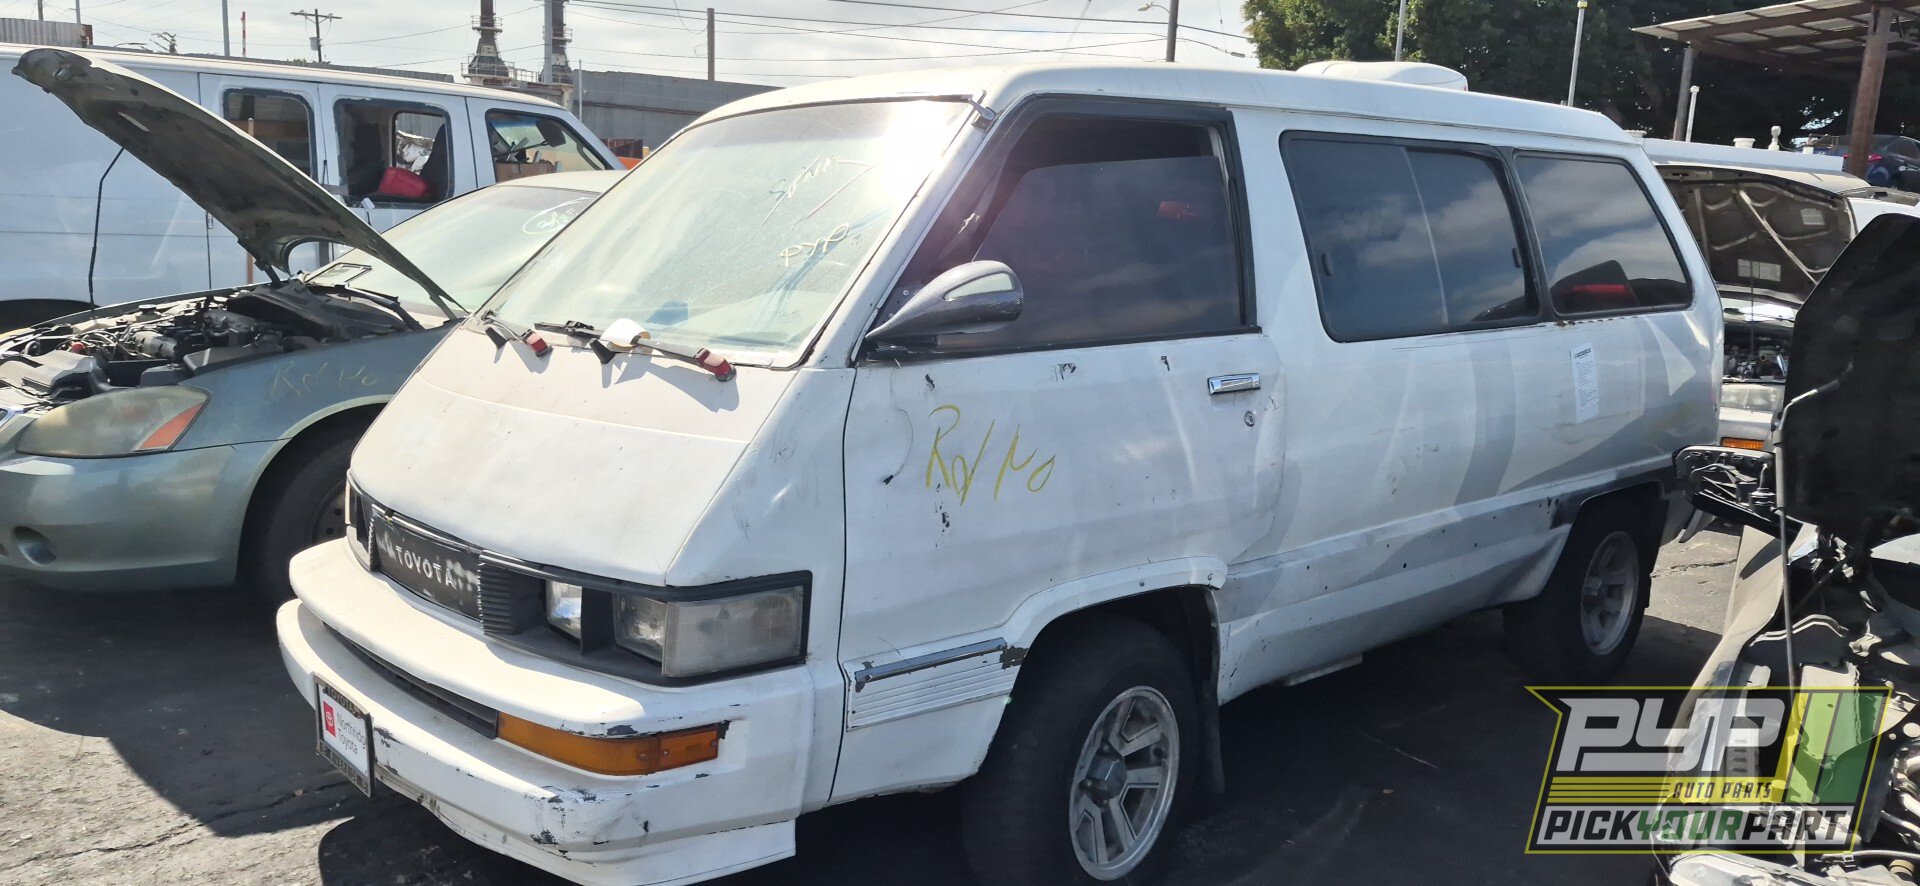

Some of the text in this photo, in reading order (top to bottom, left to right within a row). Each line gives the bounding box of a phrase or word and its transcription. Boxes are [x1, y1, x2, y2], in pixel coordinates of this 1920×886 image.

[395, 545, 457, 590] TOYOTA
[336, 711, 367, 750] Northridg
[337, 727, 358, 755] Toyota
